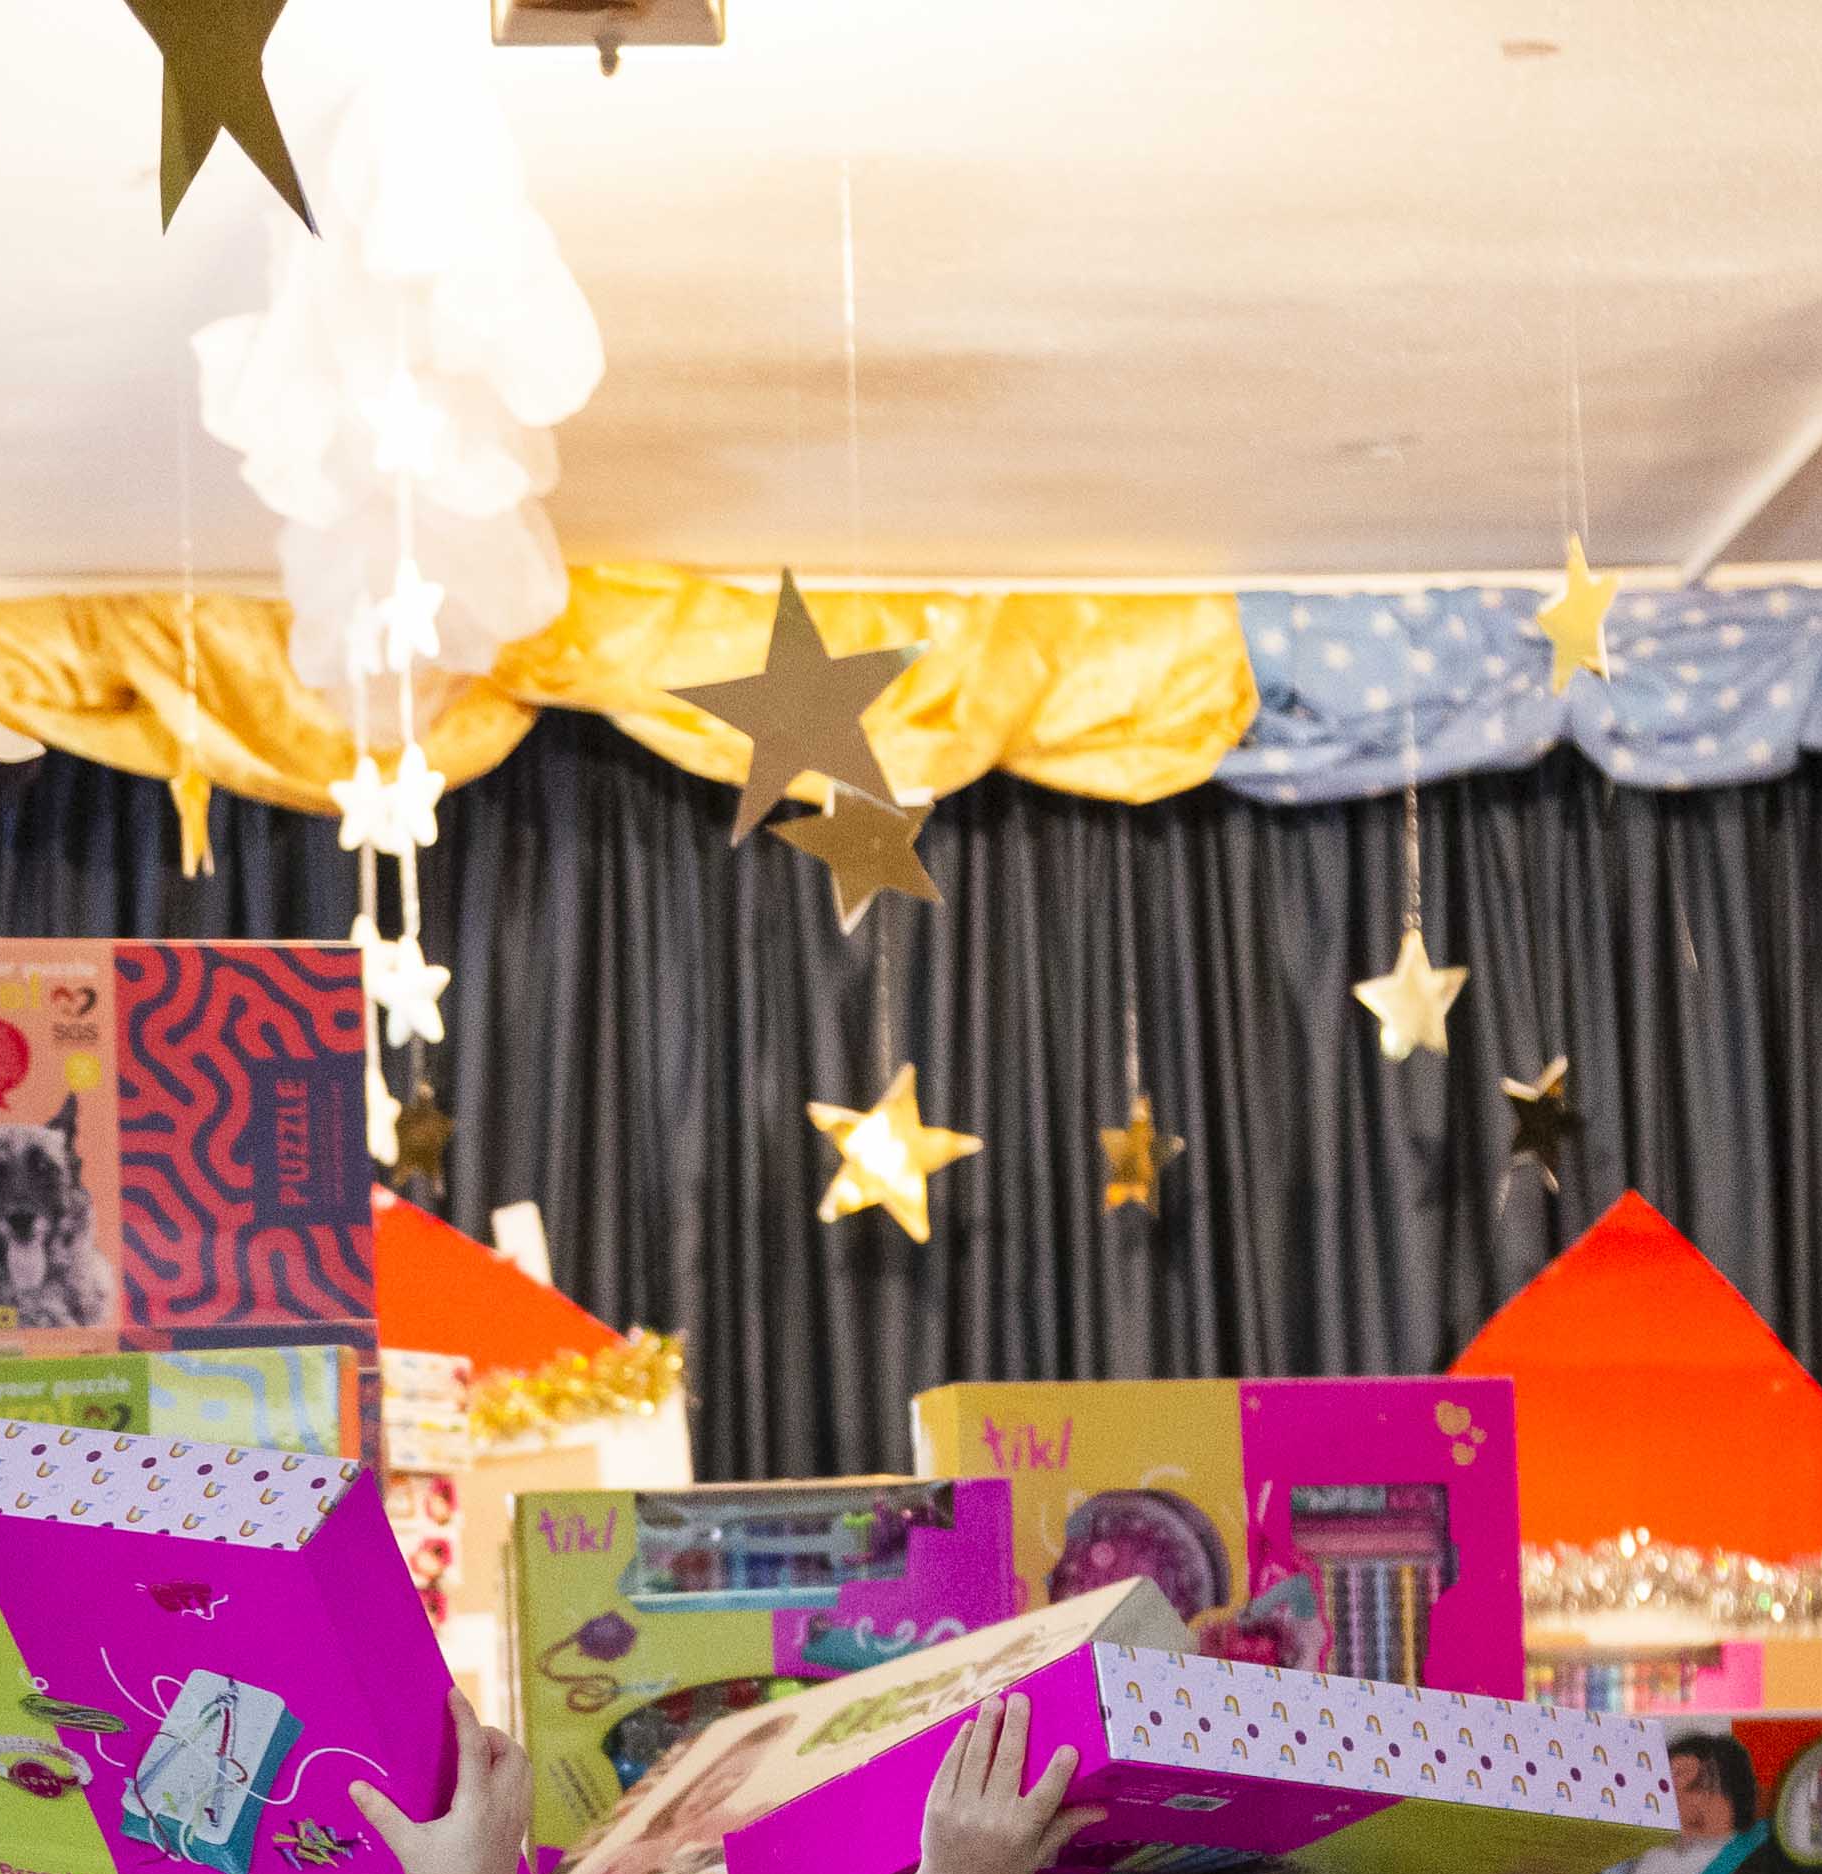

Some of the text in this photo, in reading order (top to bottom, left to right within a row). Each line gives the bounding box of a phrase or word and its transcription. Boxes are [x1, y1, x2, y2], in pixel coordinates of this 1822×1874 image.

[275, 1078, 310, 1206] PUZZLE
[52, 1373, 131, 1398] puzzle
[980, 1415, 1074, 1472] tikl
